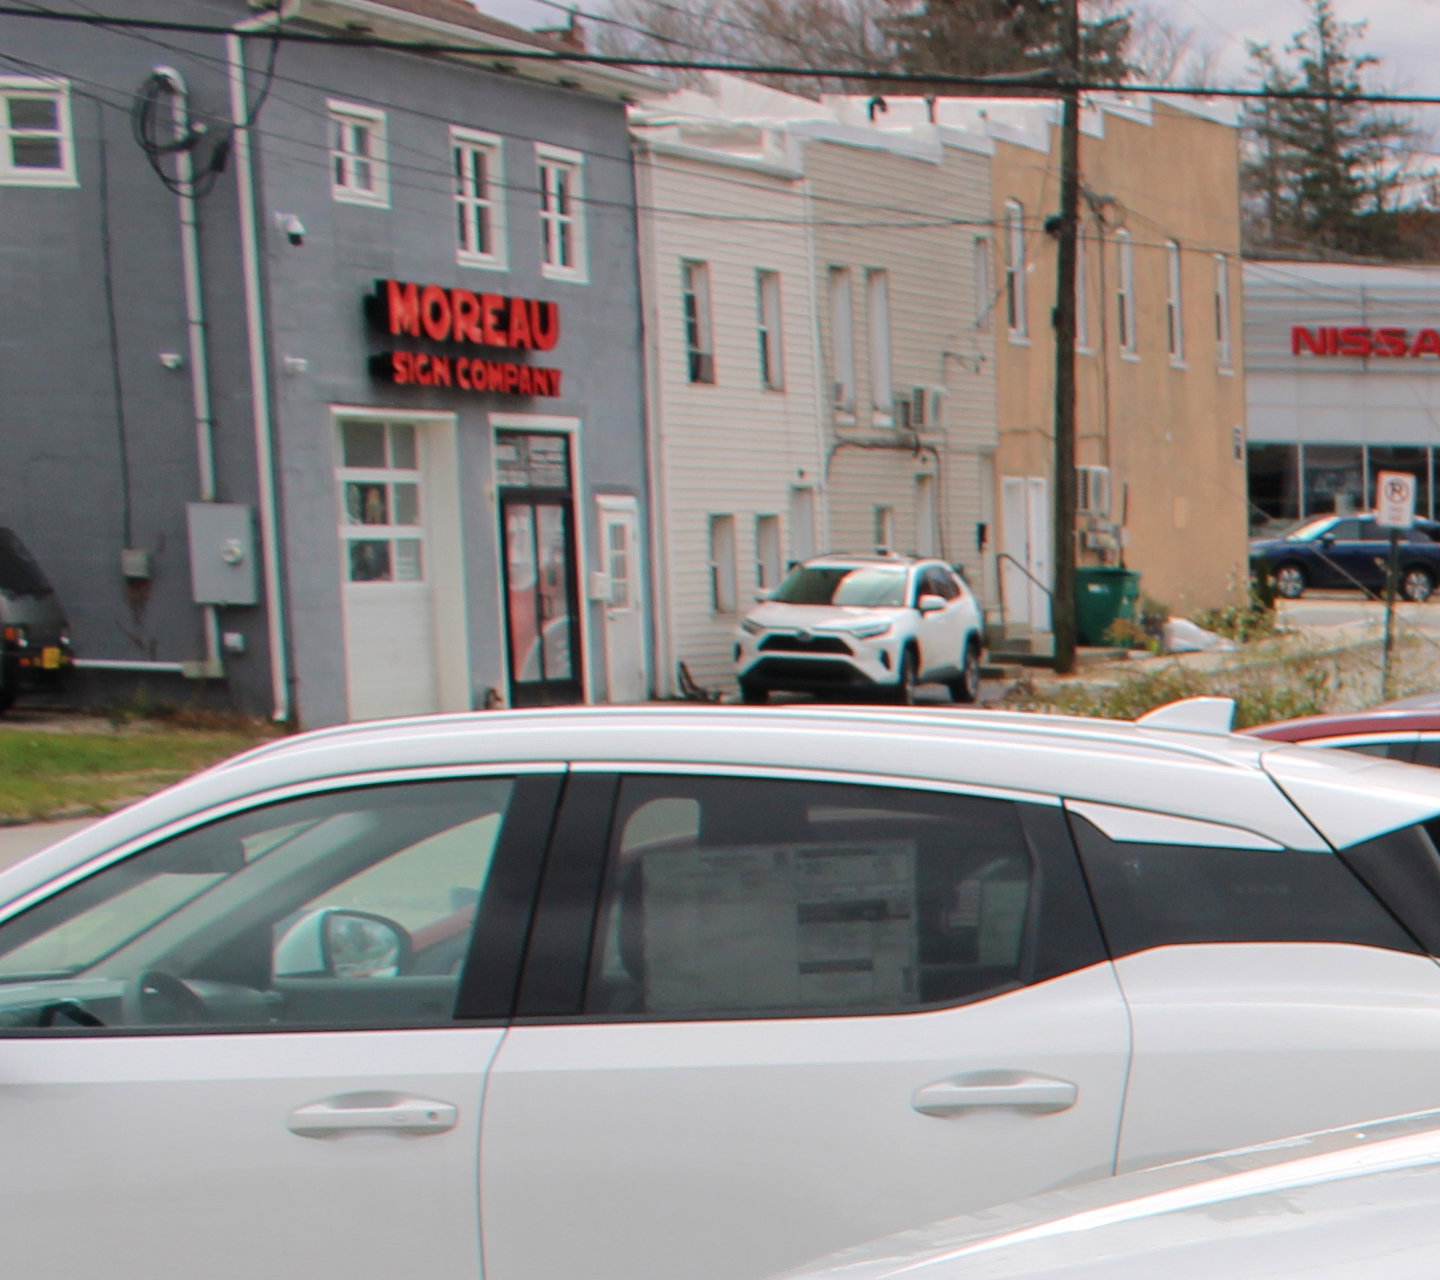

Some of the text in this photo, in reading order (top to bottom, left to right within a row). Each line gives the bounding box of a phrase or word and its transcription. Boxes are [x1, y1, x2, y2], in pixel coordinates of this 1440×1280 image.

[386, 279, 560, 352] MOREAU
[392, 351, 563, 398] SIGN COMPANY
